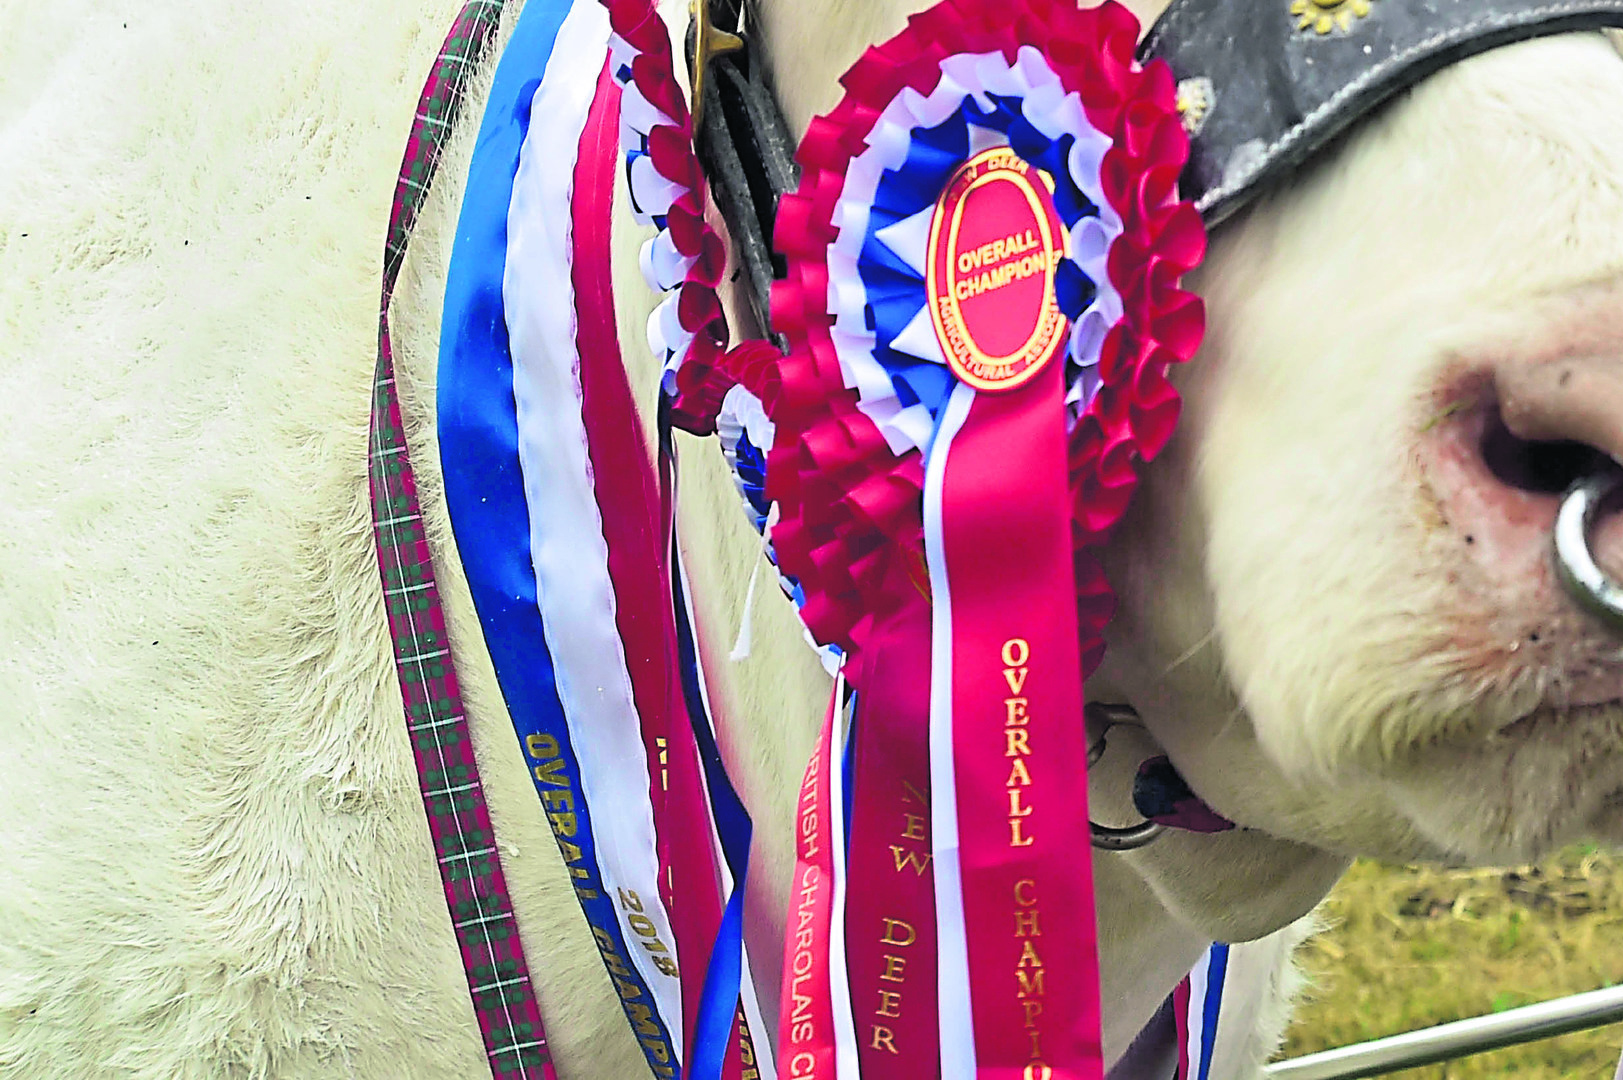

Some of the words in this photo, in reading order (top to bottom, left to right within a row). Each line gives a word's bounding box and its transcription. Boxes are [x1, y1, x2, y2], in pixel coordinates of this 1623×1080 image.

[956, 251, 1047, 302] CHAMPION
[958, 229, 1039, 273] OVERALL
[938, 295, 1016, 380] AGRICULTURAL
[1001, 637, 1034, 848] OVERALL
[888, 778, 934, 877] NEW
[617, 886, 680, 979] 2018
[790, 864, 823, 1045] CHAROLAIS
[869, 917, 917, 1056] DEER
